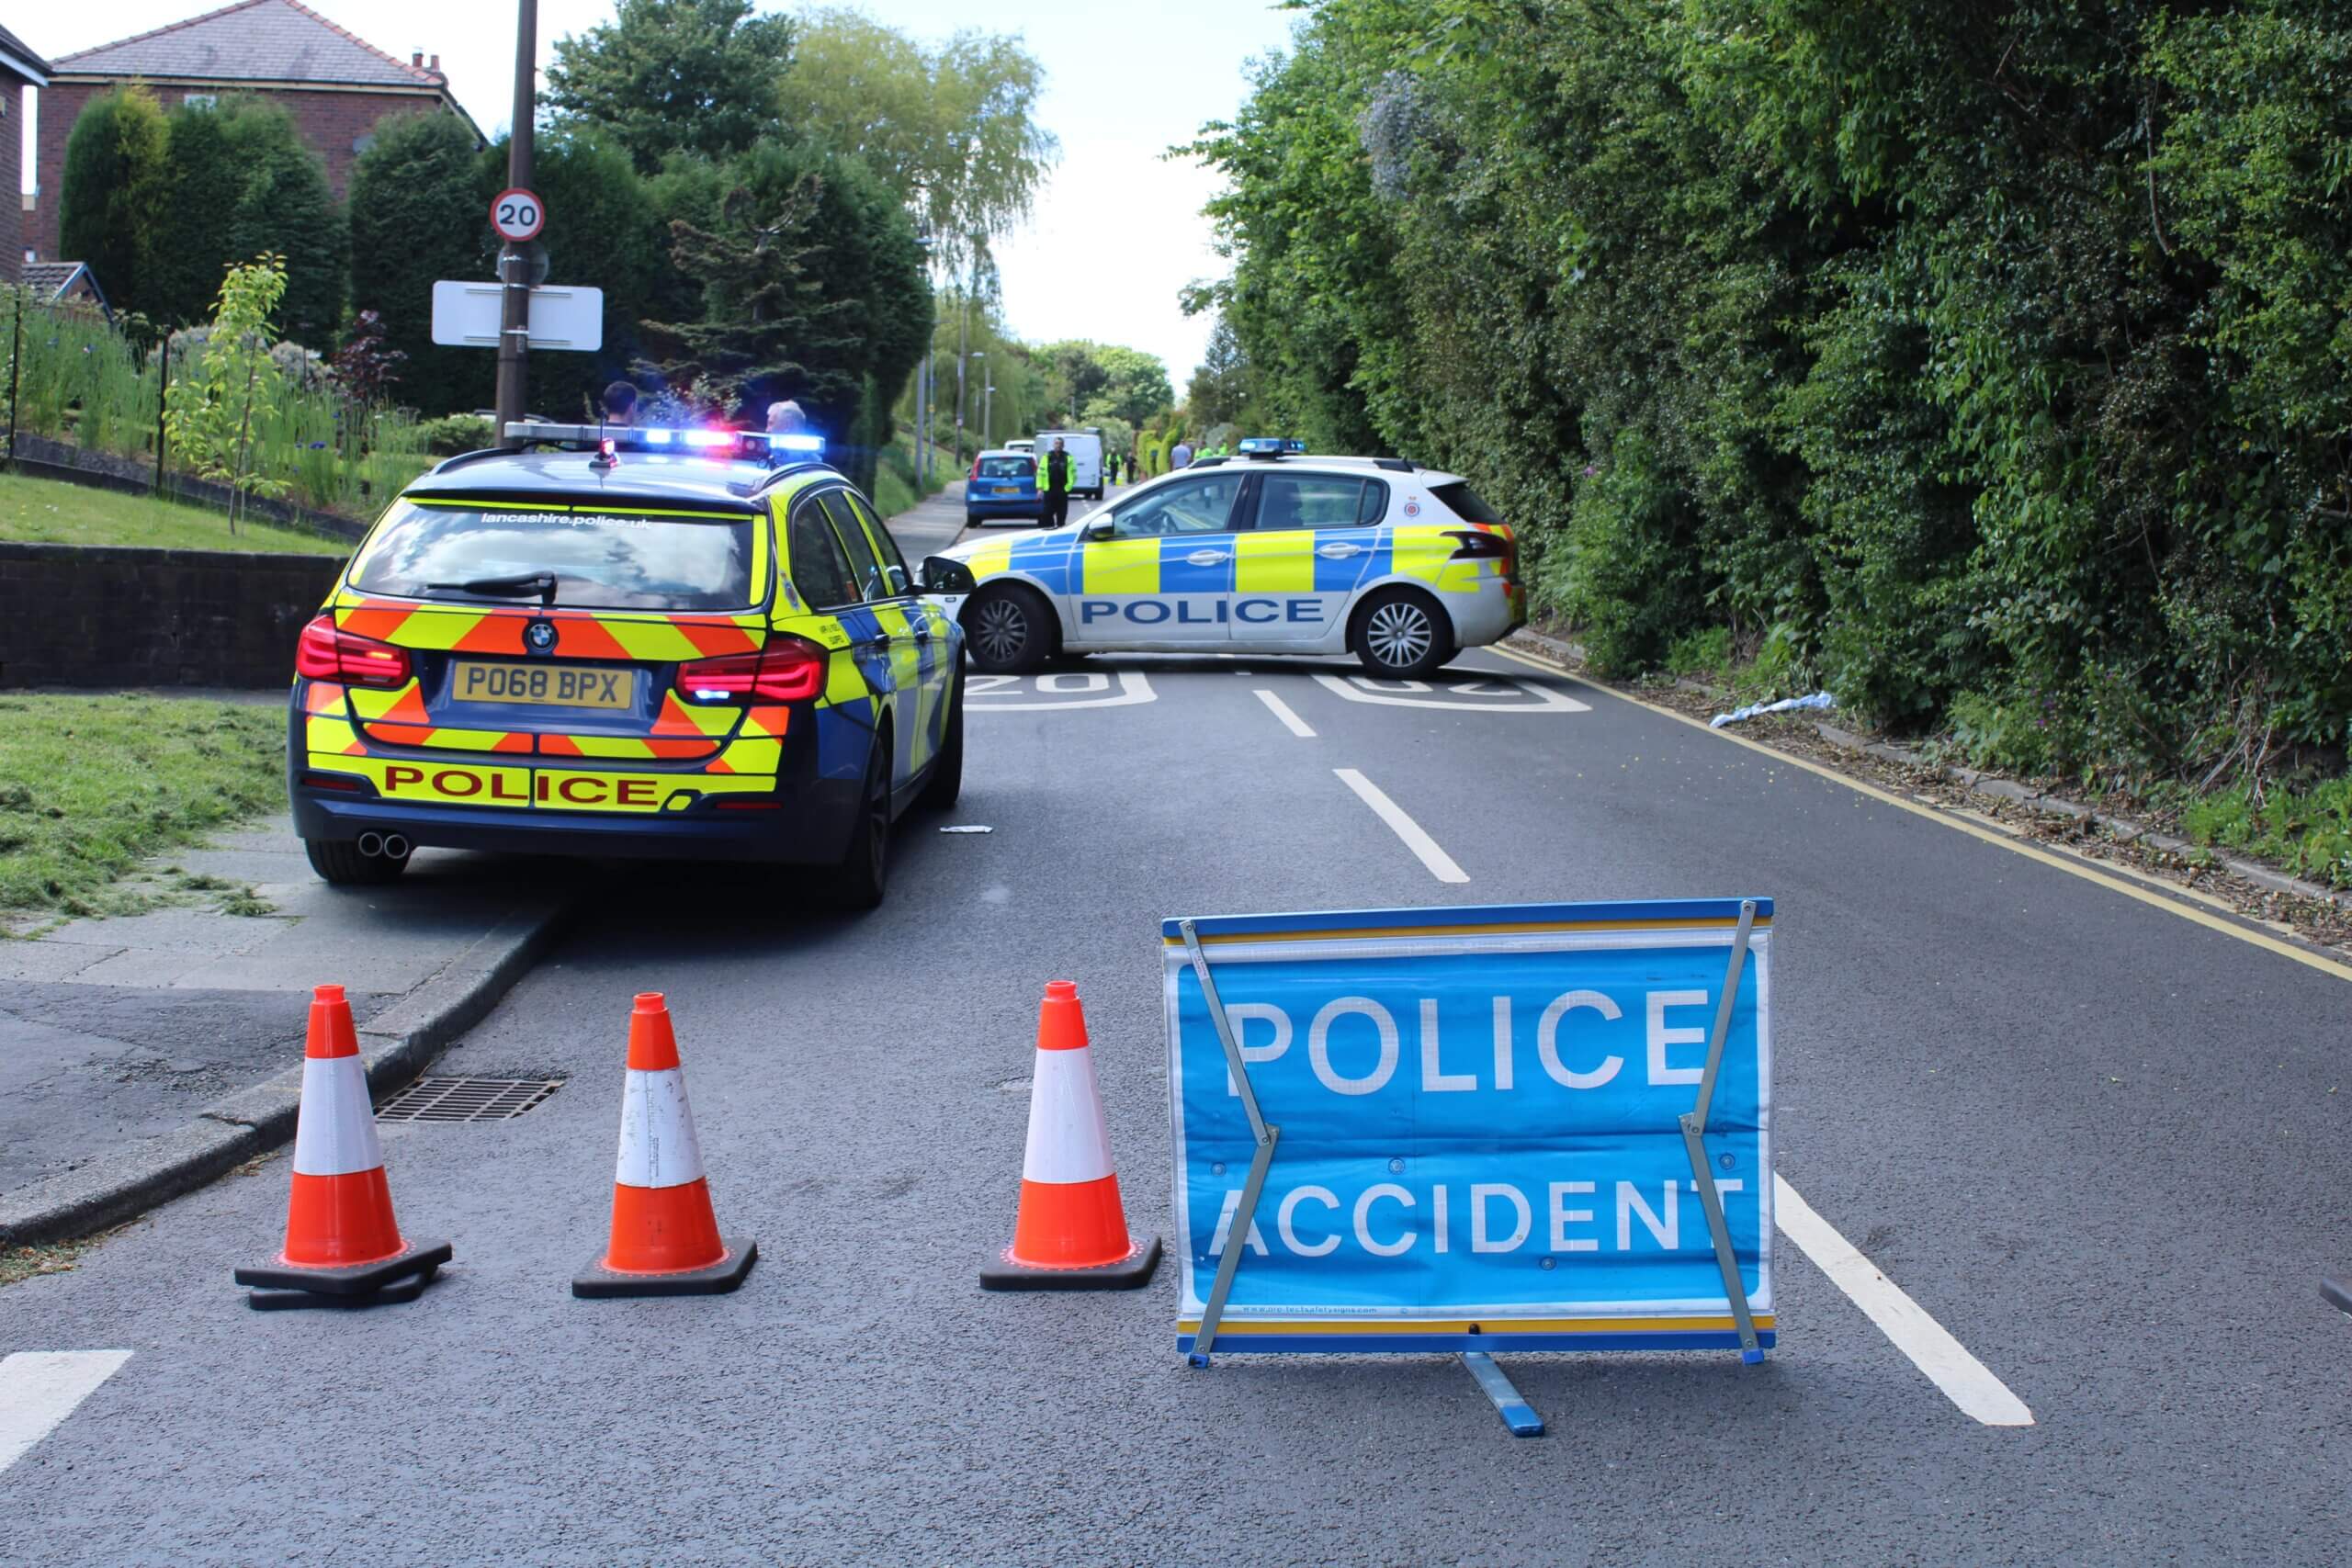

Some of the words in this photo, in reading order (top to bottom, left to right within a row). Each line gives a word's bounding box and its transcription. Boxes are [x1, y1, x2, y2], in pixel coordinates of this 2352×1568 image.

[499, 204, 537, 227] 20
[481, 513, 653, 530] lancashire.police.uk
[1081, 599, 1325, 625] POLICE
[467, 667, 548, 698] PO68
[557, 671, 619, 702] BPX
[385, 765, 658, 807] POLICE
[1225, 988, 1710, 1097] POLICE
[1208, 1179, 1743, 1258] ACCIDENT
